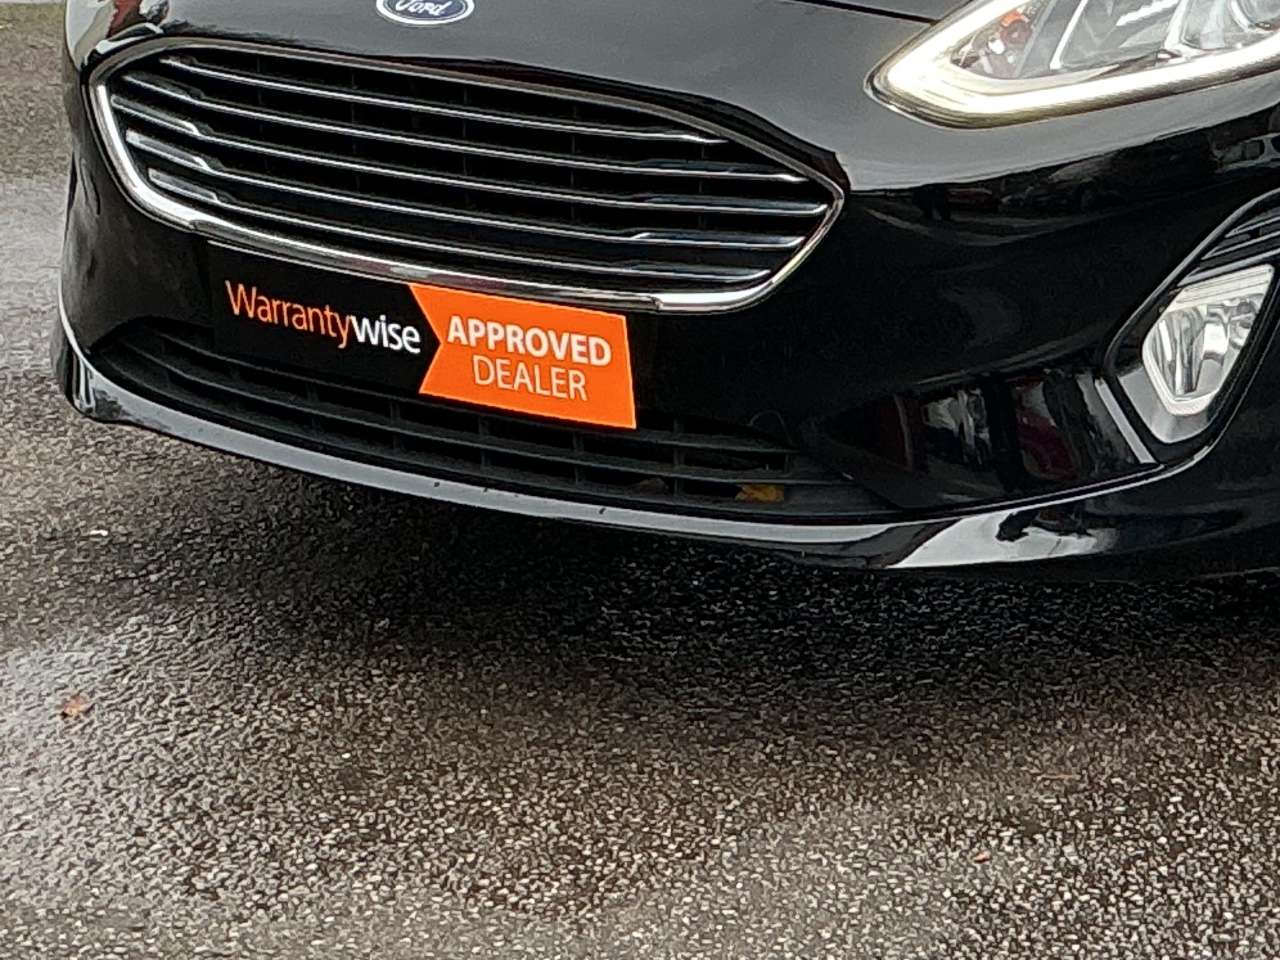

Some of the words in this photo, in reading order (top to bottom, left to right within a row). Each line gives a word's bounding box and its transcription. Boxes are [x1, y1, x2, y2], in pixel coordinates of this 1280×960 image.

[224, 280, 421, 354] Warrantywise
[447, 315, 612, 367] APPROVED
[472, 354, 589, 401] DEALER
